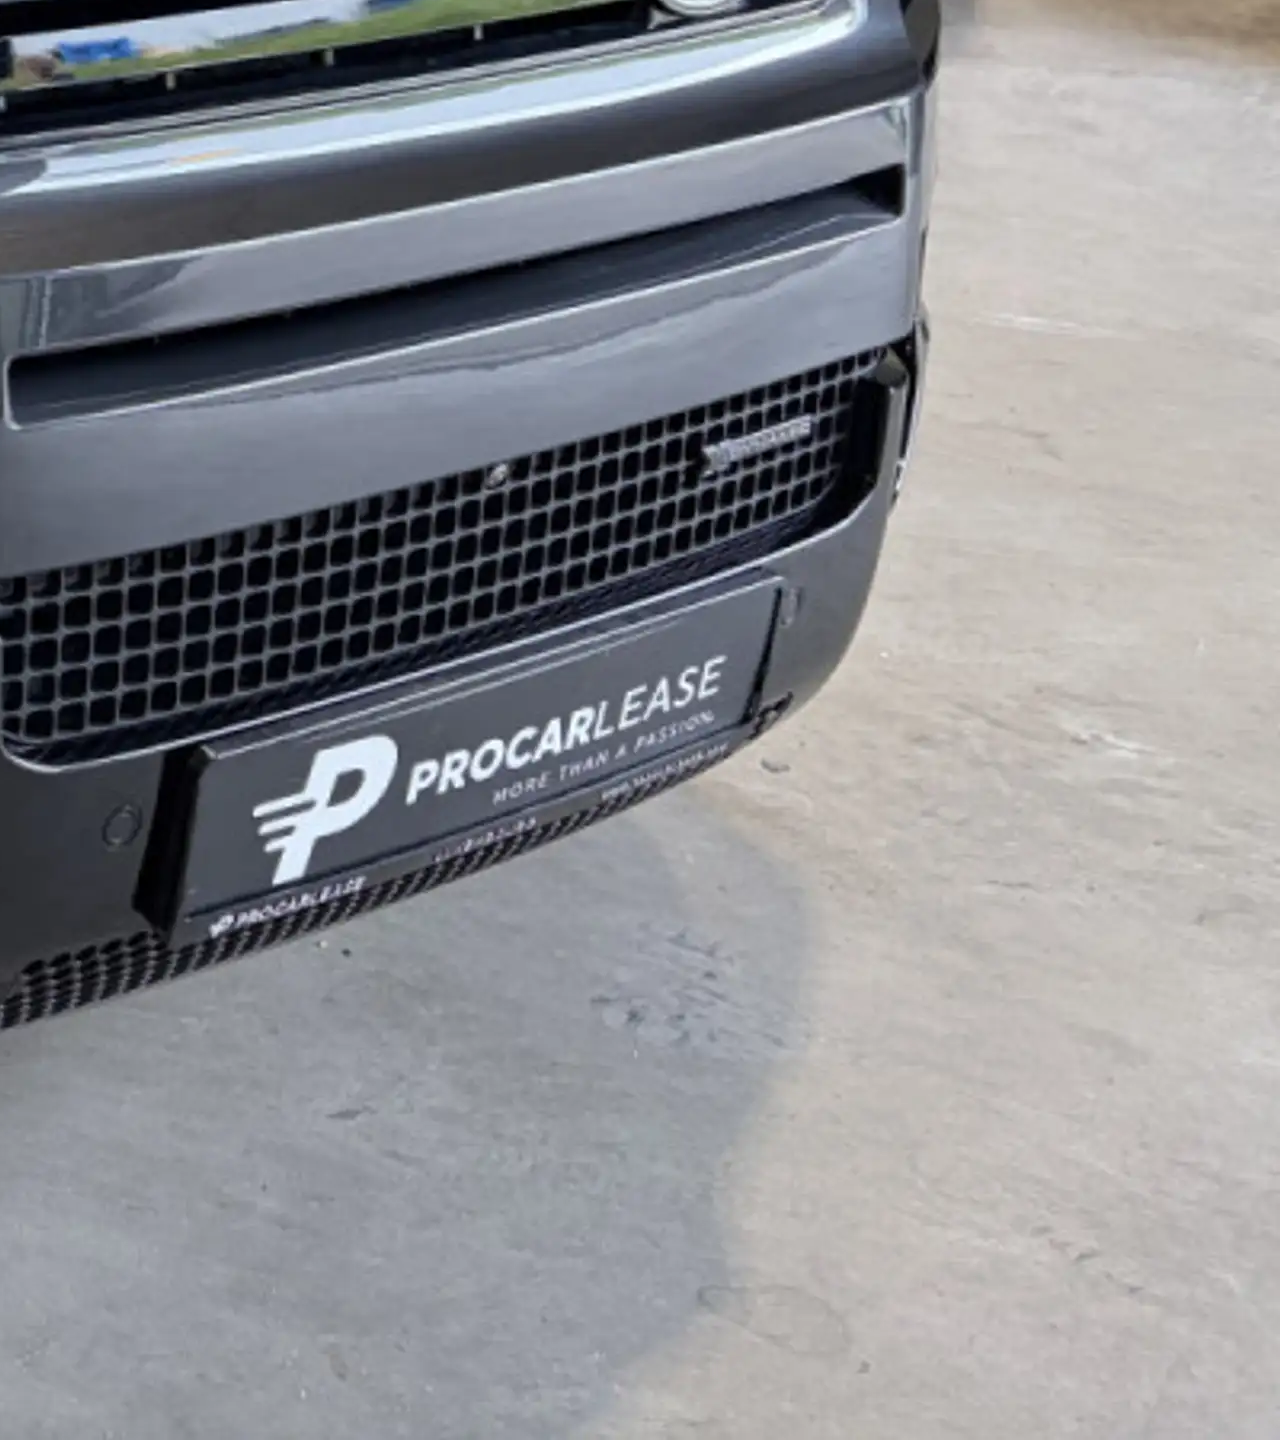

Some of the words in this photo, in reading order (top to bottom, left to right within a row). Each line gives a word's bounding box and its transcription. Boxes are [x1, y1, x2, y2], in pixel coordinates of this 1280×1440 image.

[405, 654, 728, 806] PROCARLEASE
[492, 770, 553, 806] MORE
[559, 749, 610, 781] THAN
[614, 744, 628, 760] A
